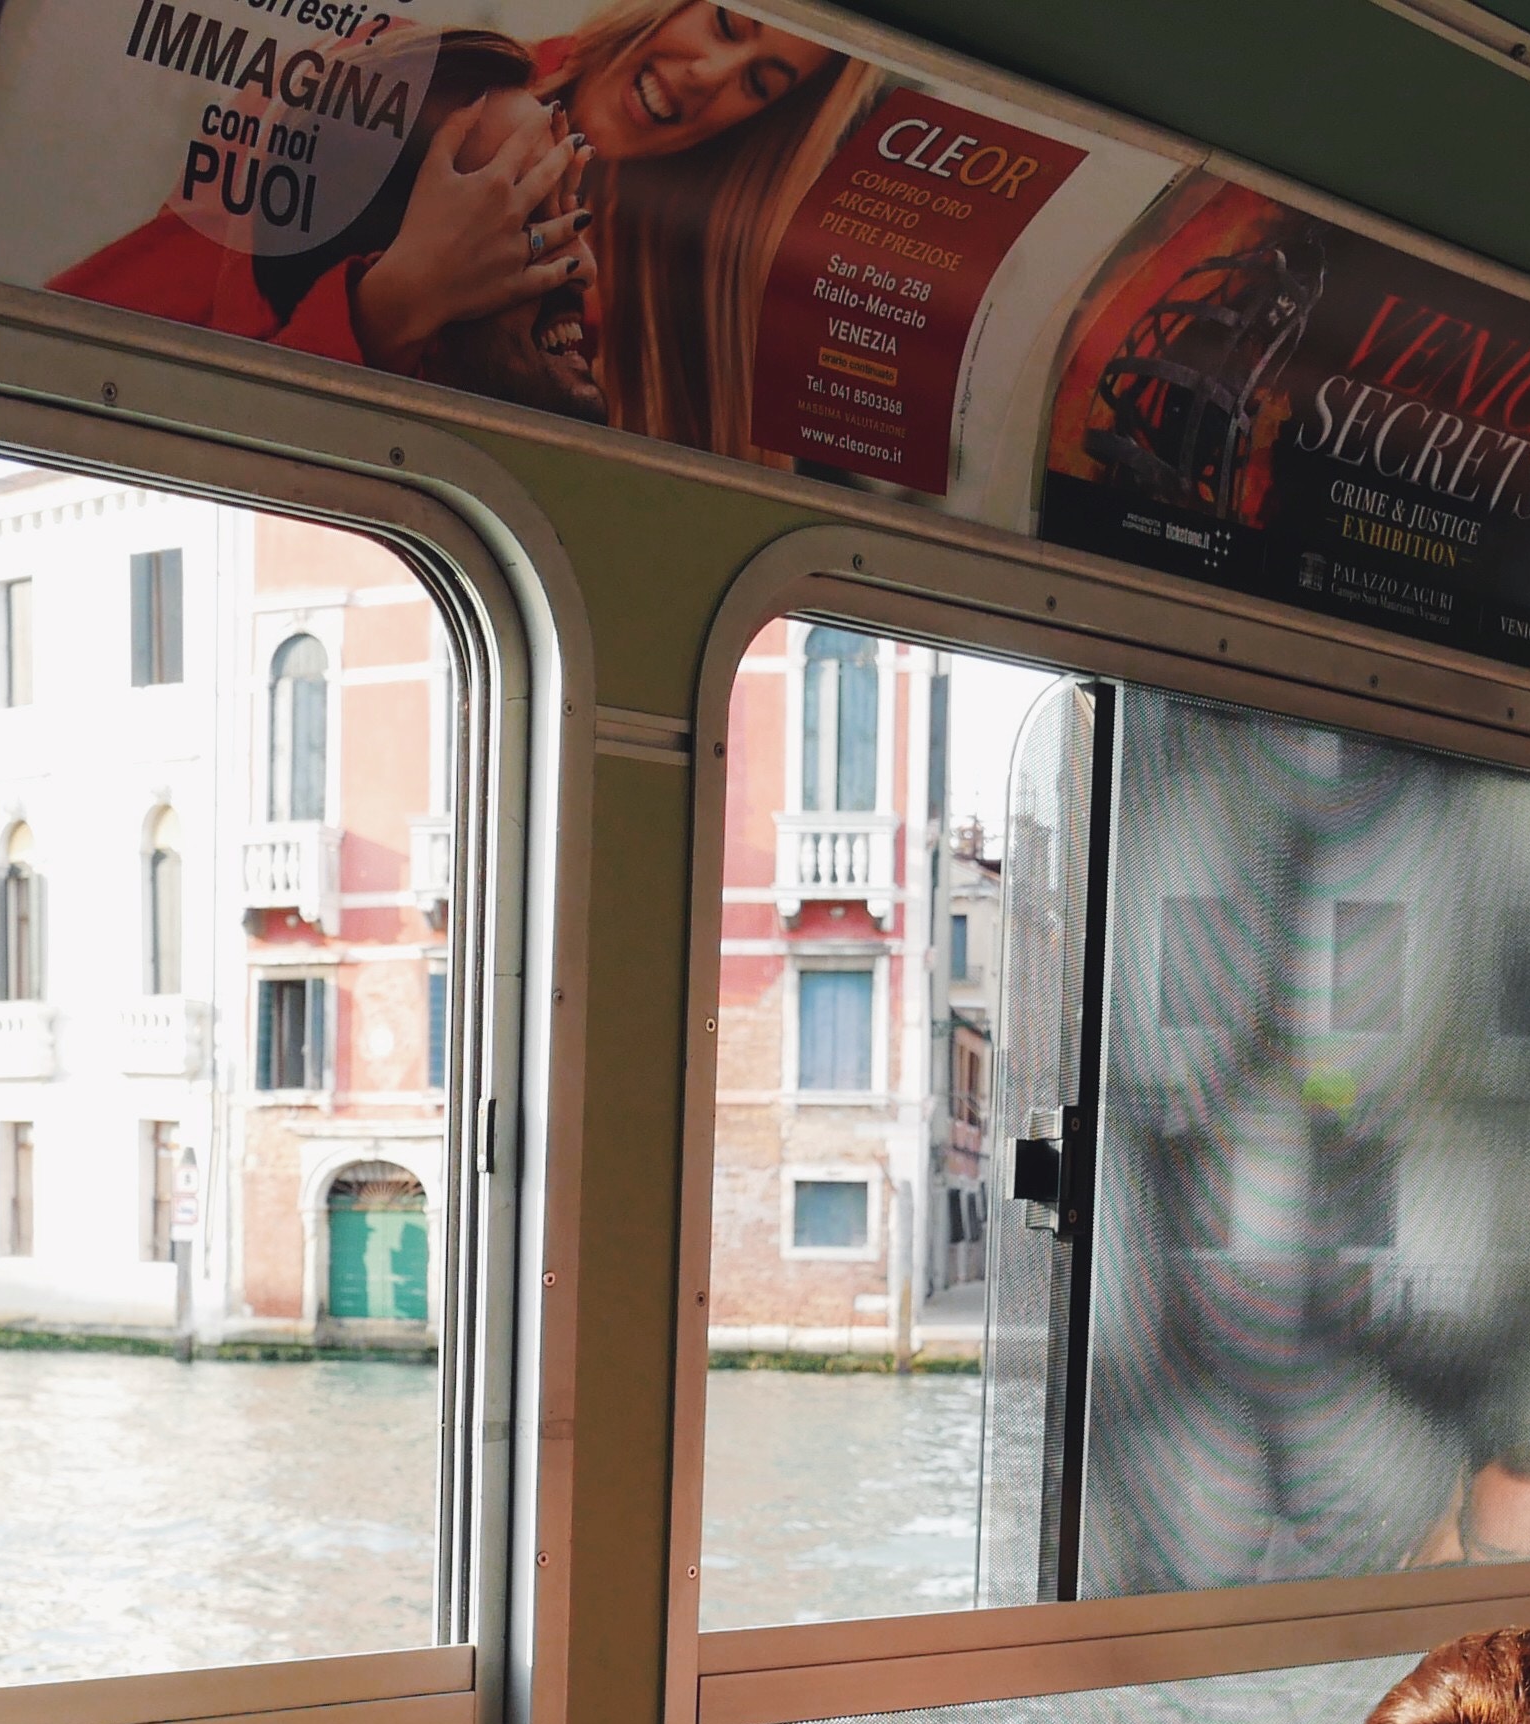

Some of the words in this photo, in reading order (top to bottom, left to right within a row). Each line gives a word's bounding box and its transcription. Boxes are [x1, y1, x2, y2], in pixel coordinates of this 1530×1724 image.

[233, 0, 368, 39] resti
[126, 0, 410, 140] IMMAGINA
[201, 103, 261, 148] con
[267, 122, 321, 164] noi
[877, 118, 1040, 199] CLEOR
[182, 140, 317, 233] PUOI
[832, 190, 920, 230] ARGENTO
[850, 169, 930, 207] COMPRO
[931, 196, 973, 221] ORO
[819, 212, 882, 247] PIETRE
[880, 231, 963, 272] PREZIOSE
[813, 277, 926, 329] Rialto-Mercato
[827, 254, 858, 280] San
[862, 265, 896, 293] Polo
[899, 278, 931, 302] 258
[828, 317, 897, 356] VENEZIA
[797, 399, 842, 421] MASSIMA
[844, 411, 908, 439] VALUTAZIONE
[806, 374, 827, 395] Tel.
[829, 382, 850, 401] 041
[853, 389, 903, 415] 8503368
[800, 426, 902, 464] www.cleororo.it
[1330, 478, 1389, 519] CRIME
[1391, 498, 1407, 524] &
[1408, 503, 1482, 547] JUSTICE
[1341, 513, 1459, 568] EXHIBITION
[1332, 561, 1398, 595] PALAZZO
